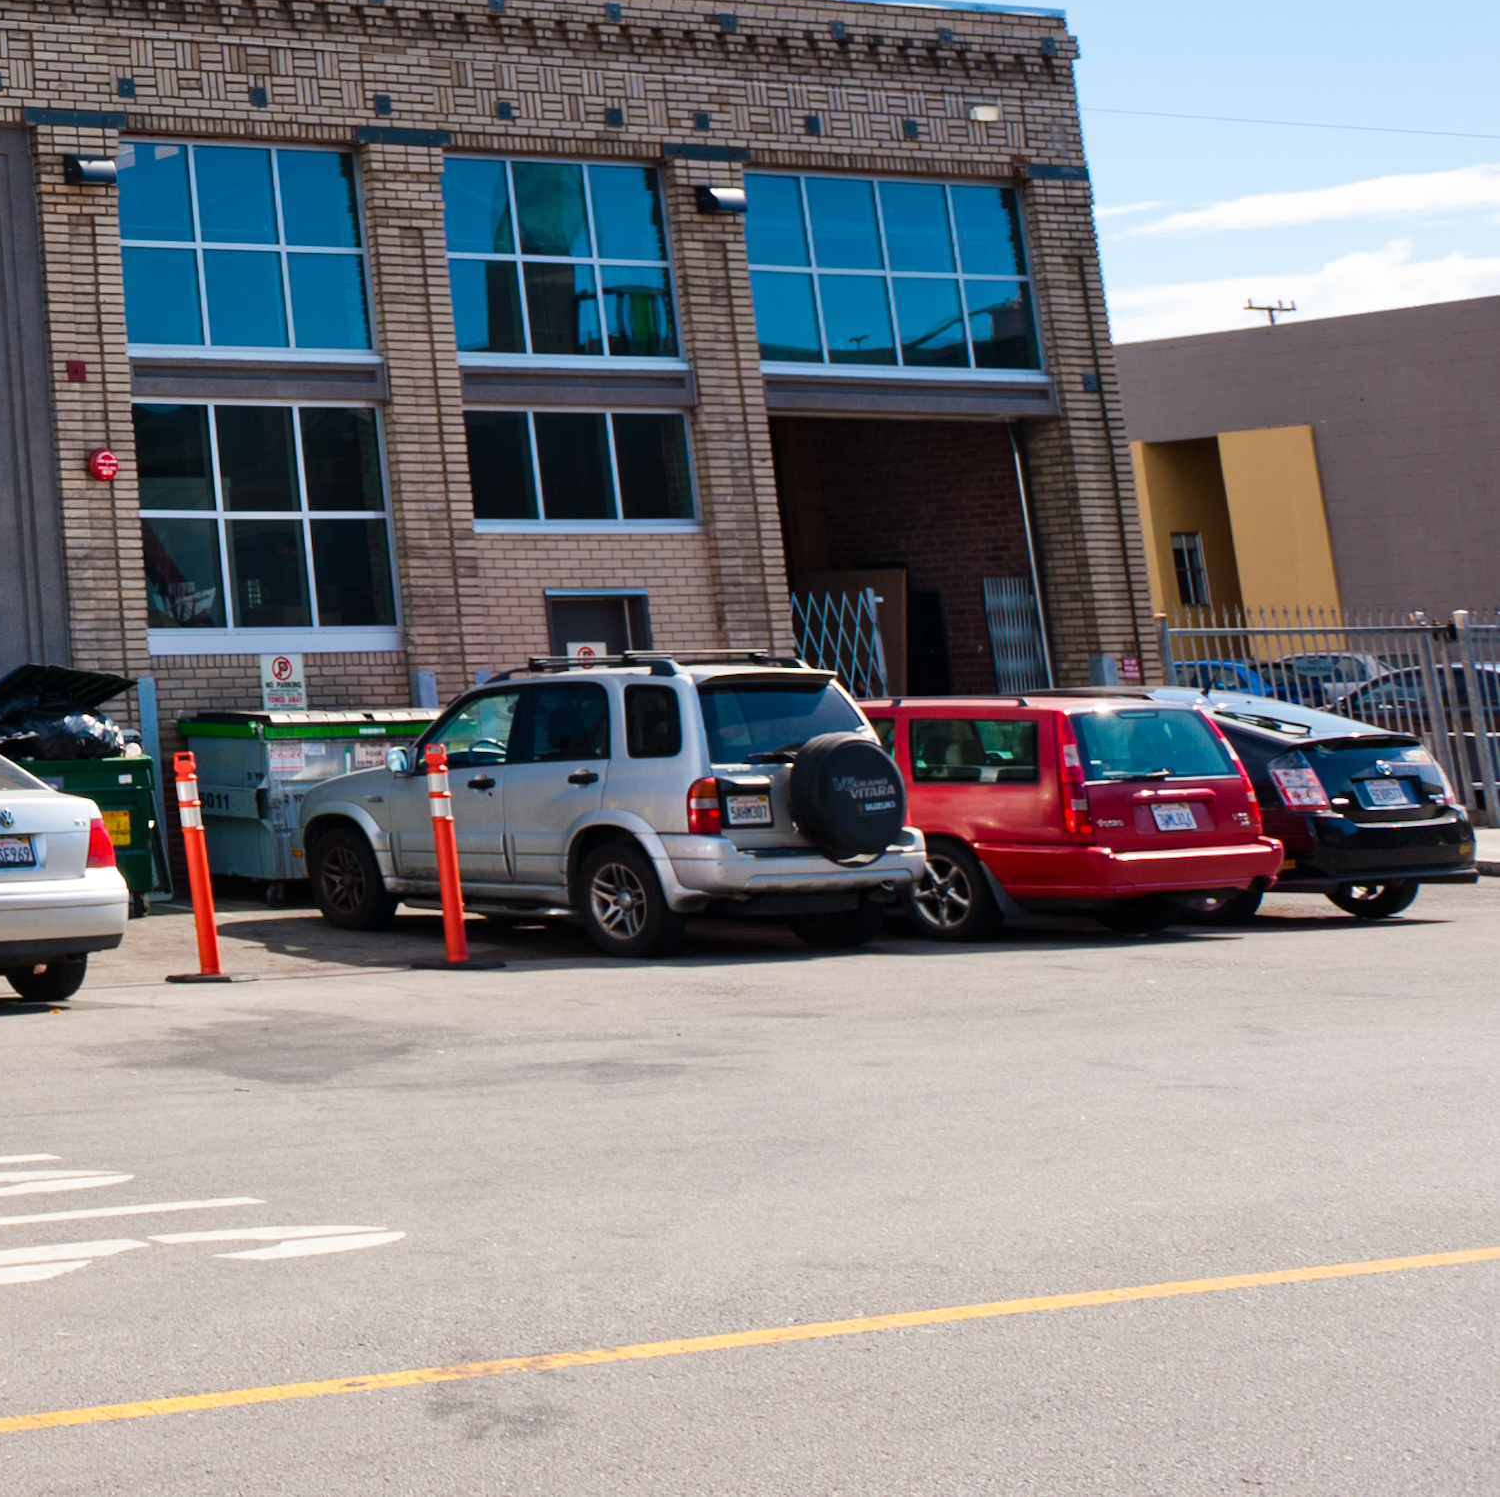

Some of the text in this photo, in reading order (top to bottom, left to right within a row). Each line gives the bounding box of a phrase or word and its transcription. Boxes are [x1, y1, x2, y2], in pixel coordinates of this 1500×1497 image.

[276, 681, 302, 689] PARKING
[850, 784, 896, 799] VITARA
[864, 800, 896, 812] SUZUKI
